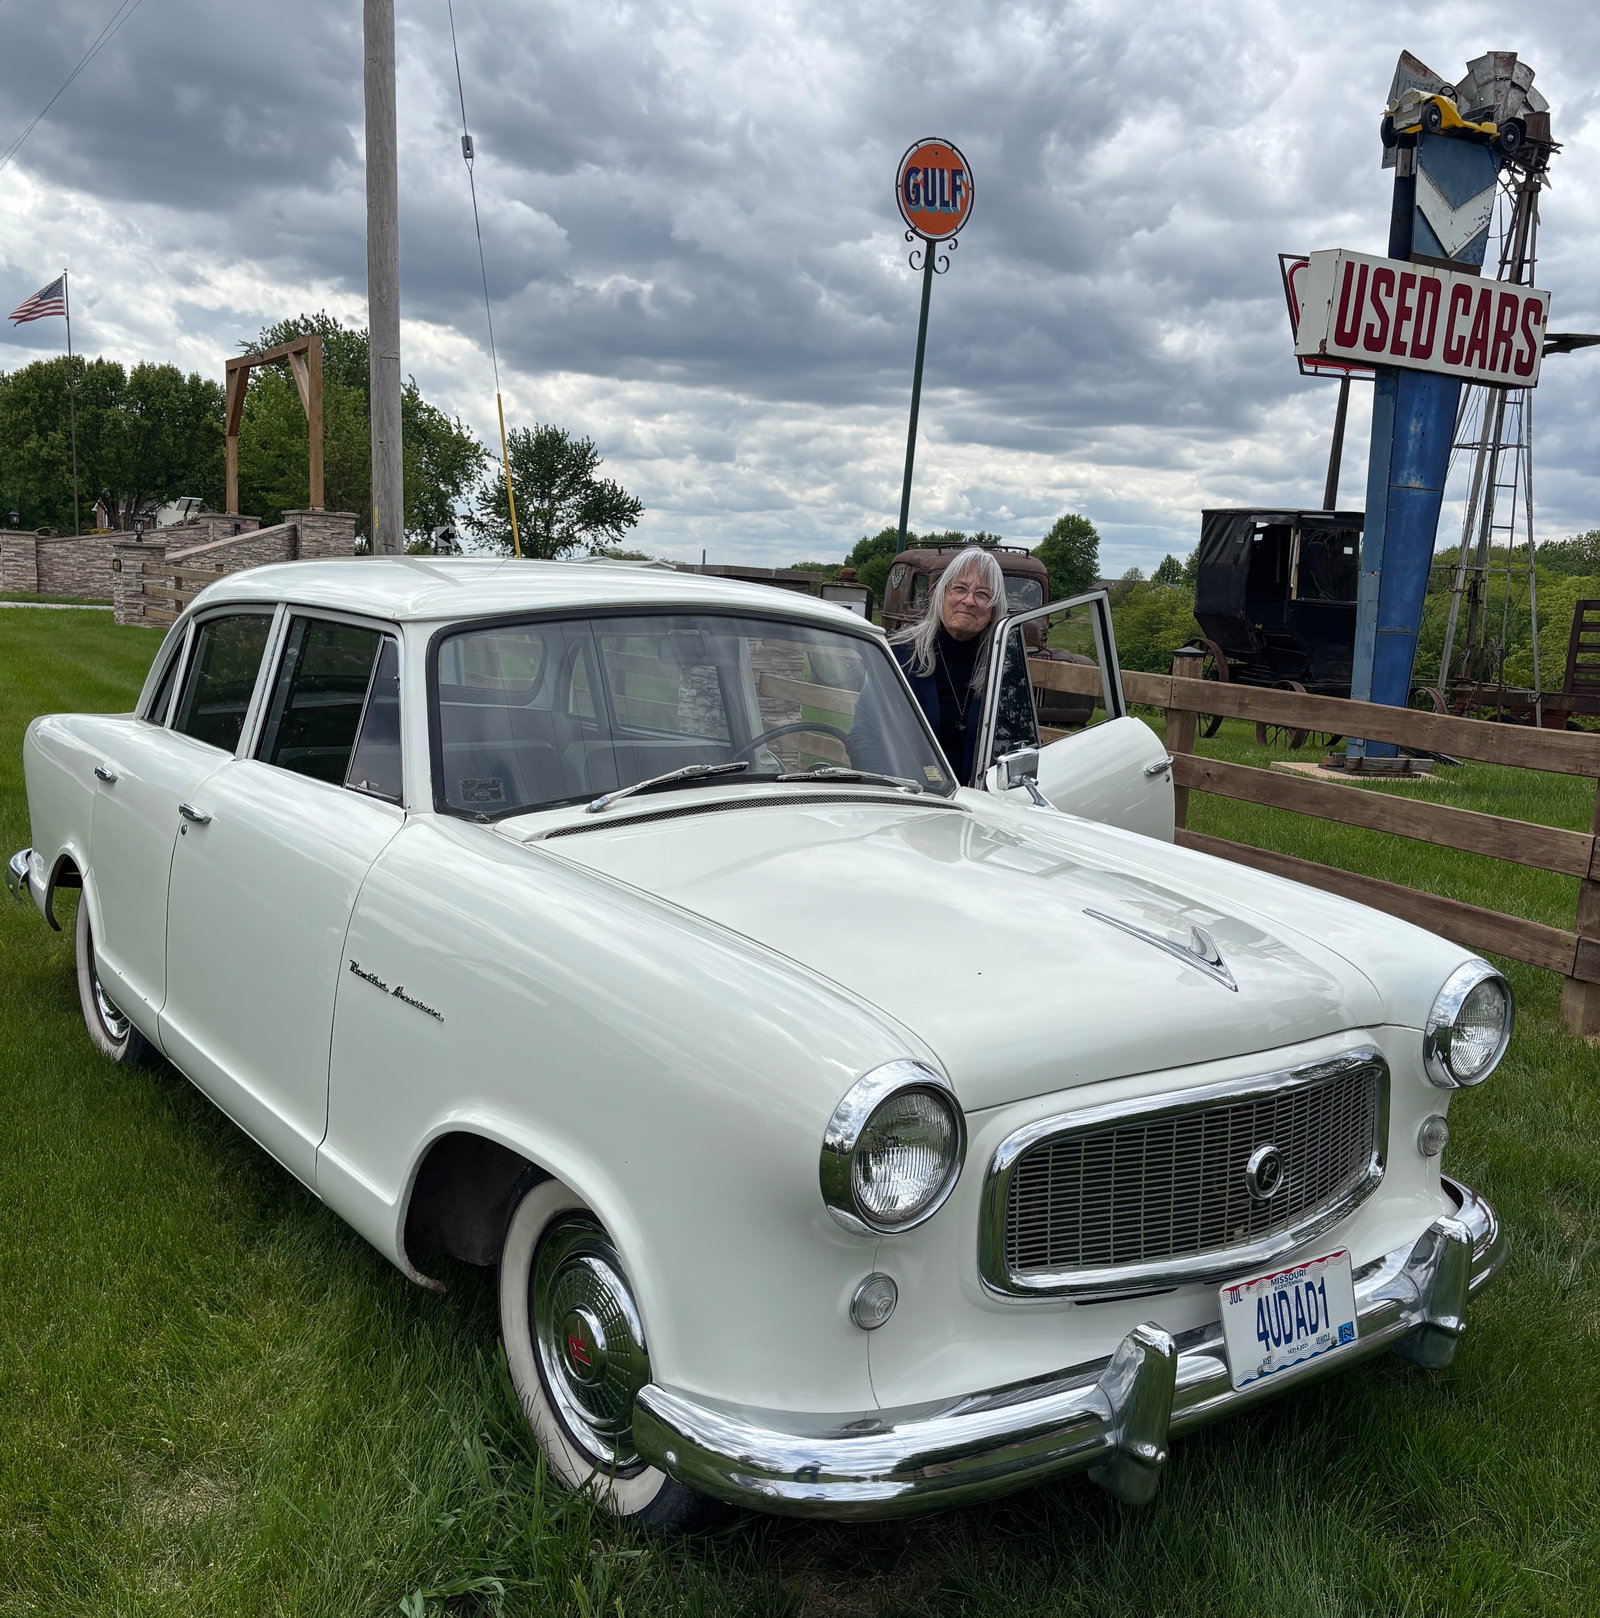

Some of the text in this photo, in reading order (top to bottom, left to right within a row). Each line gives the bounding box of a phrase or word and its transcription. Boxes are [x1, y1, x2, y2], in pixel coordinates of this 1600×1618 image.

[904, 166, 966, 212] GULF
[1334, 261, 1542, 377] USED CARS
[1270, 1269, 1306, 1287] MISSOURI
[1229, 1288, 1243, 1305] JUL
[1256, 1276, 1330, 1352] 4UDAD1
[1316, 1333, 1330, 1345] VEHICLE
[1343, 1325, 1351, 1338] 22
